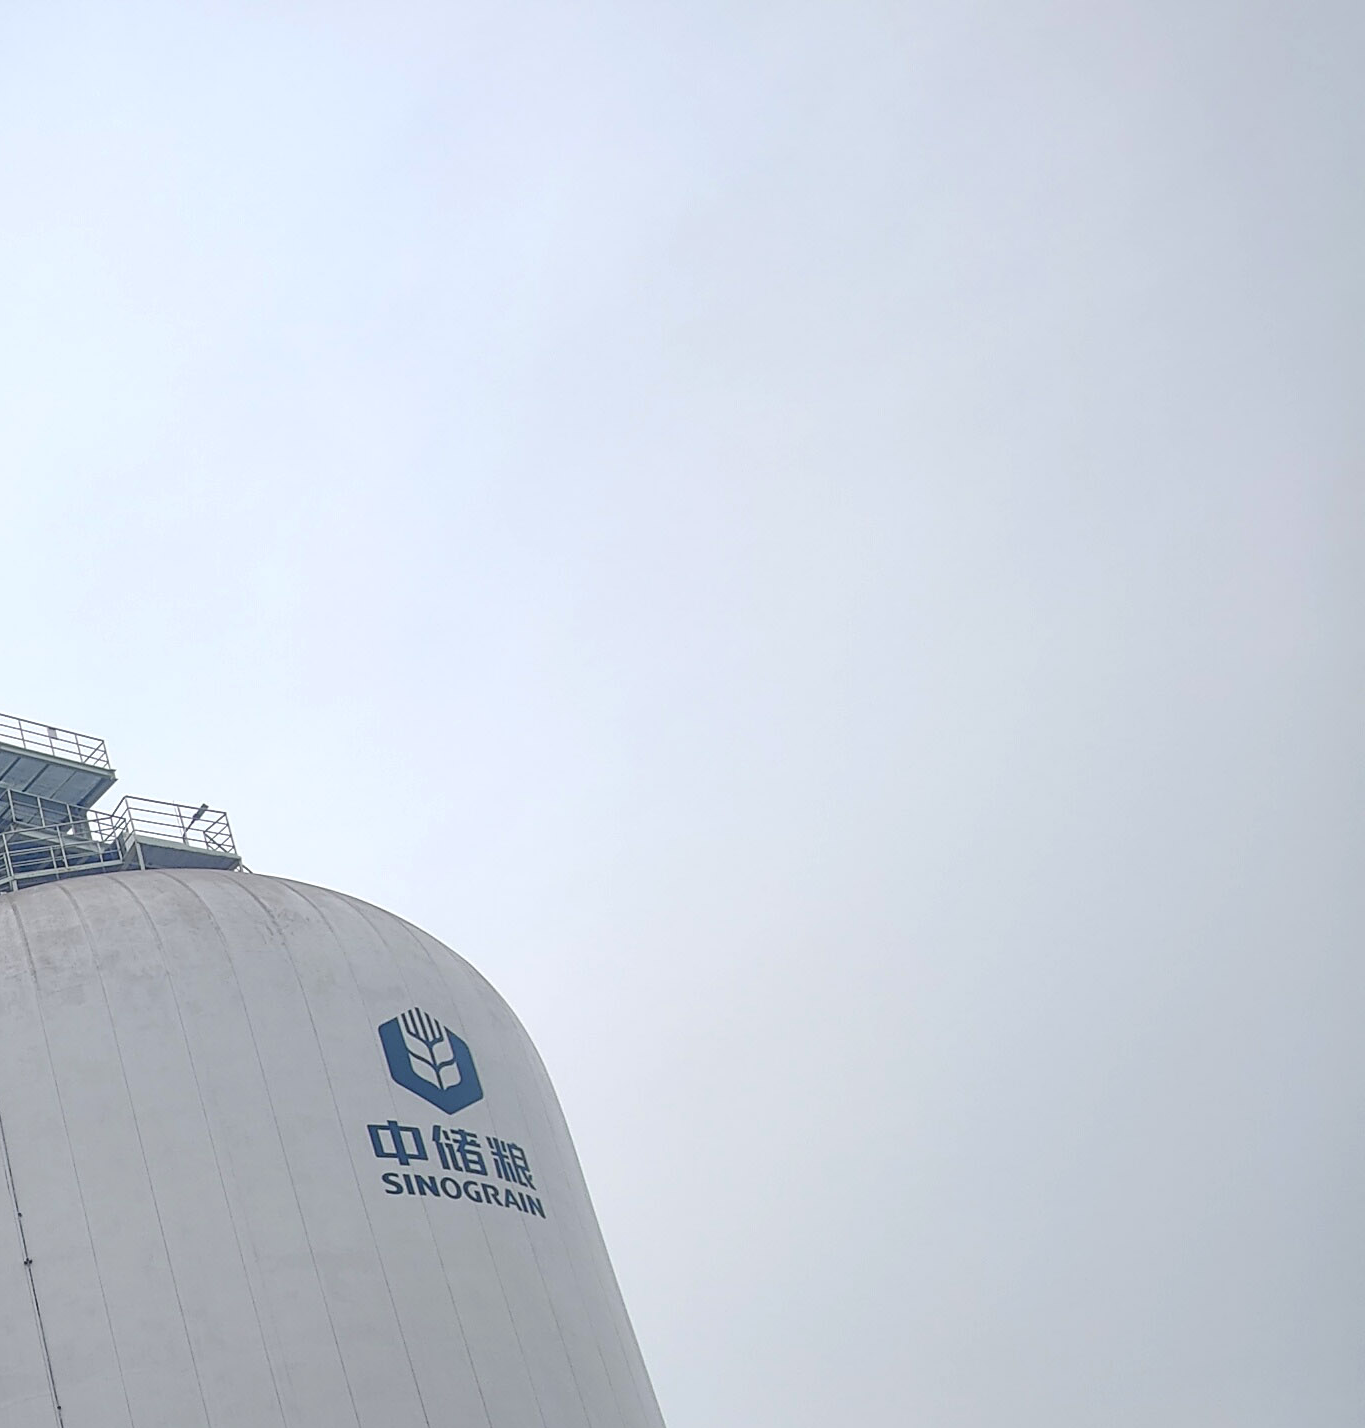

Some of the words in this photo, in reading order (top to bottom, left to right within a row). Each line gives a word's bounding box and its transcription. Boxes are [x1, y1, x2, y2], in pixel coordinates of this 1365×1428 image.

[366, 1120, 537, 1191] 中储粮
[381, 1172, 547, 1219] SINOGRAIN
